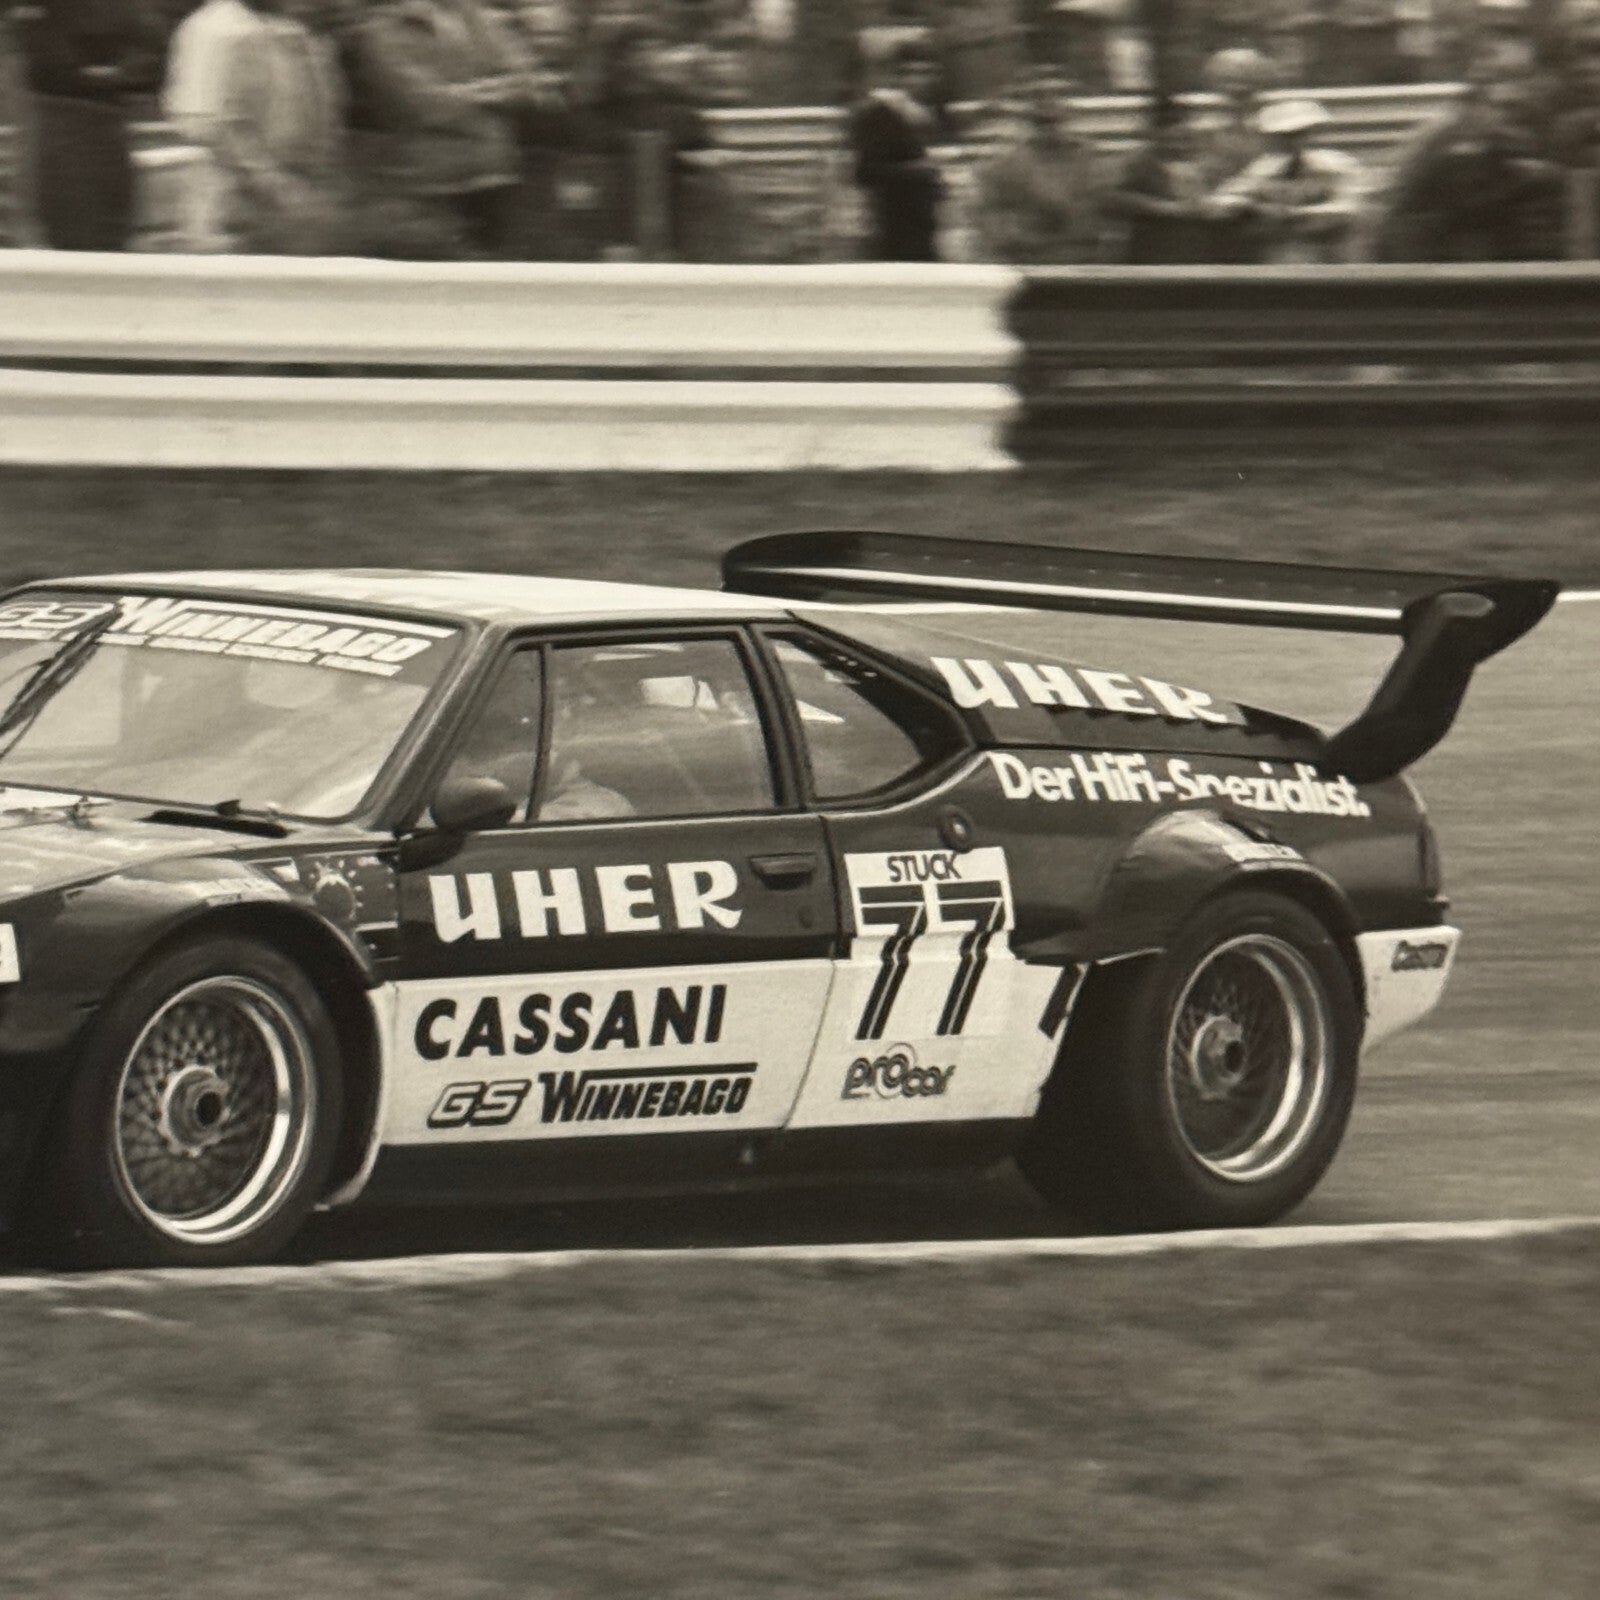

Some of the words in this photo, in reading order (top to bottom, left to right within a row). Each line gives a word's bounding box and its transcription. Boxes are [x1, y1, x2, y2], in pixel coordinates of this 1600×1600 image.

[930, 657, 1228, 723] UHER
[988, 751, 1075, 801] Der
[428, 860, 743, 943] UHER
[887, 853, 962, 883] STUCK
[856, 880, 1006, 1040] 77
[414, 984, 727, 1060] CASSANI
[427, 1079, 532, 1129] GS
[538, 1062, 758, 1123] WINNEBAGO
